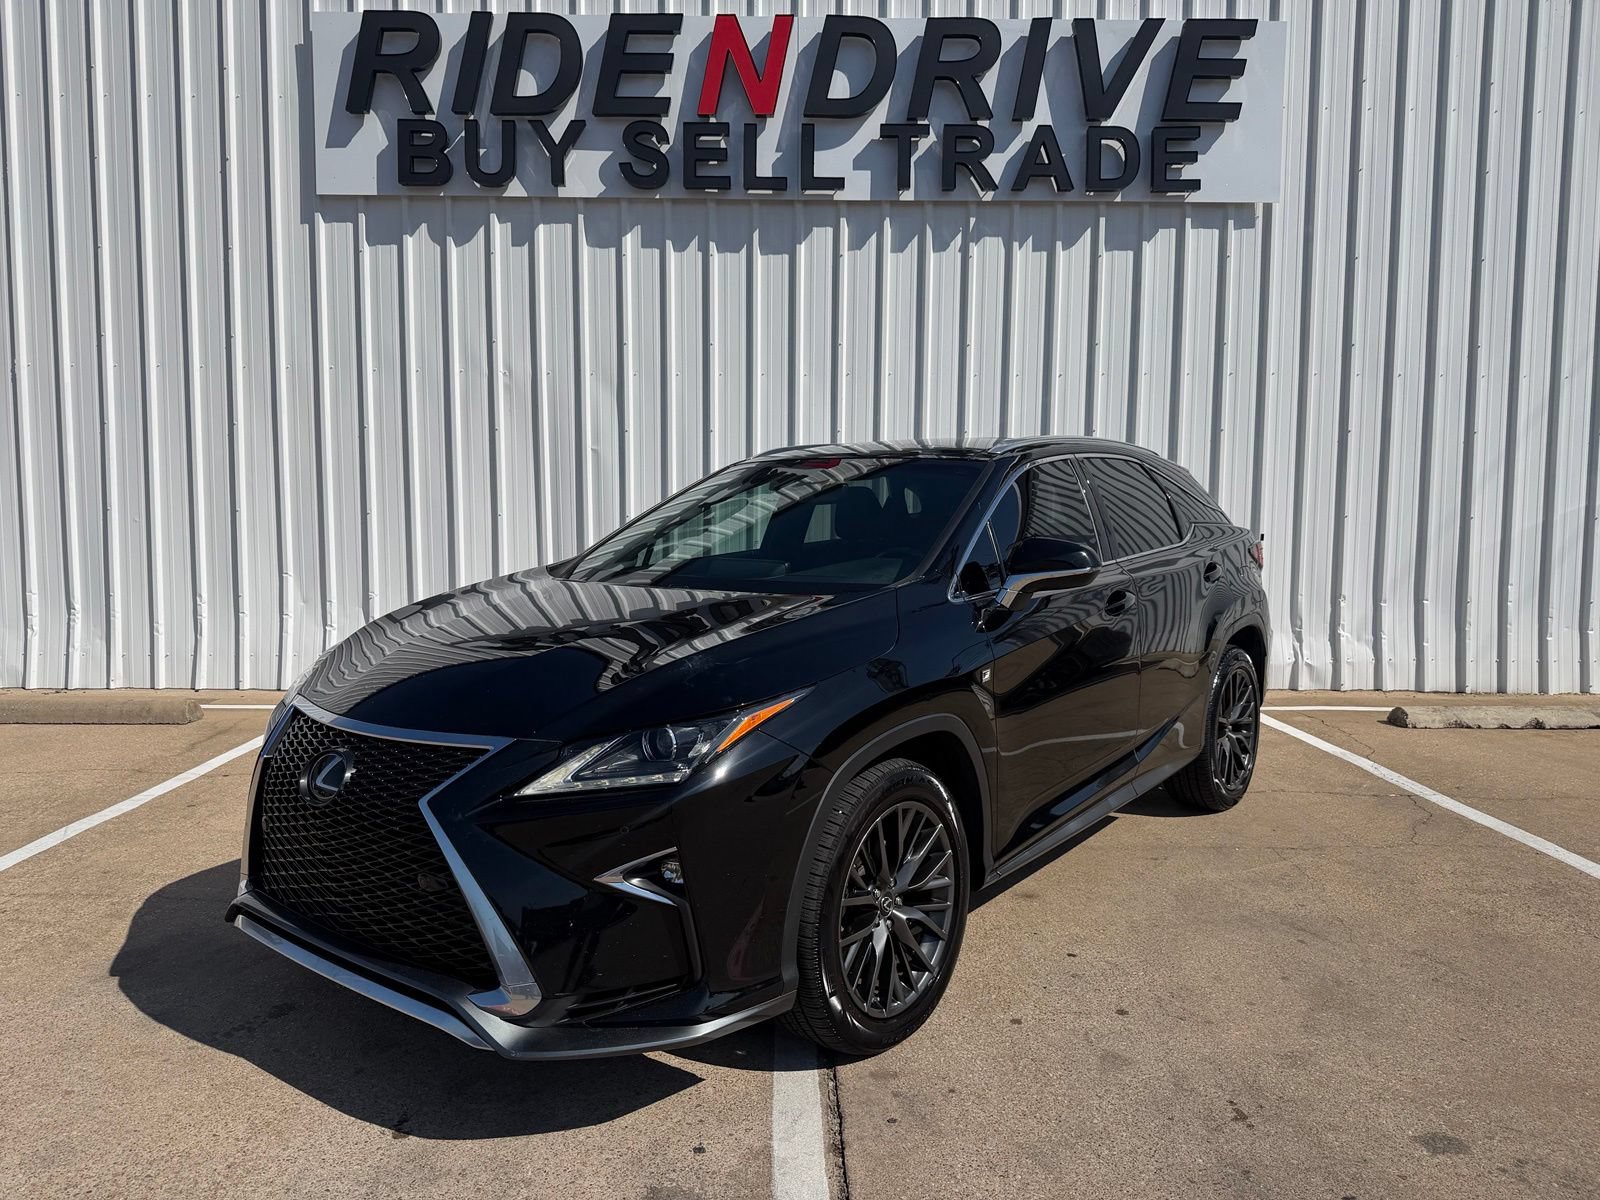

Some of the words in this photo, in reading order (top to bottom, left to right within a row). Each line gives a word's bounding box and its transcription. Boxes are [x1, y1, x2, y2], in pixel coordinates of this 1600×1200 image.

[345, 10, 1258, 122] RIDENDRIVE
[397, 119, 586, 188] BUY
[618, 120, 845, 191] SELL
[880, 124, 1201, 194] TRADE
